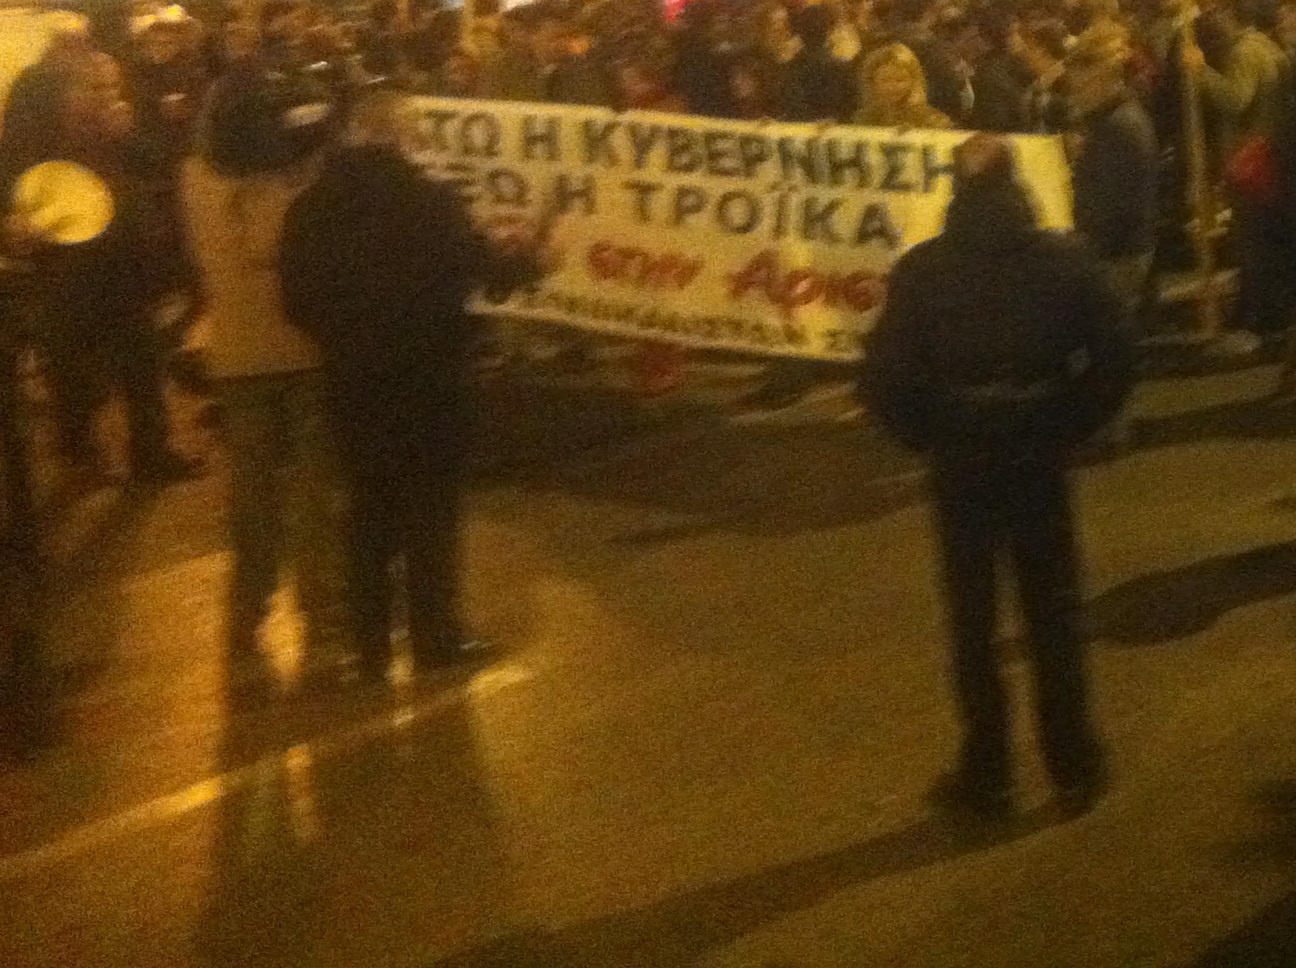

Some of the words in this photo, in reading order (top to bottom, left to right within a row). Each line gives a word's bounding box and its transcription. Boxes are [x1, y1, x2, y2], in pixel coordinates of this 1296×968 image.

[521, 112, 562, 162] Η
[581, 117, 956, 194] ΚΥΒΕΡΝΗΣΗ
[551, 172, 598, 216] Η
